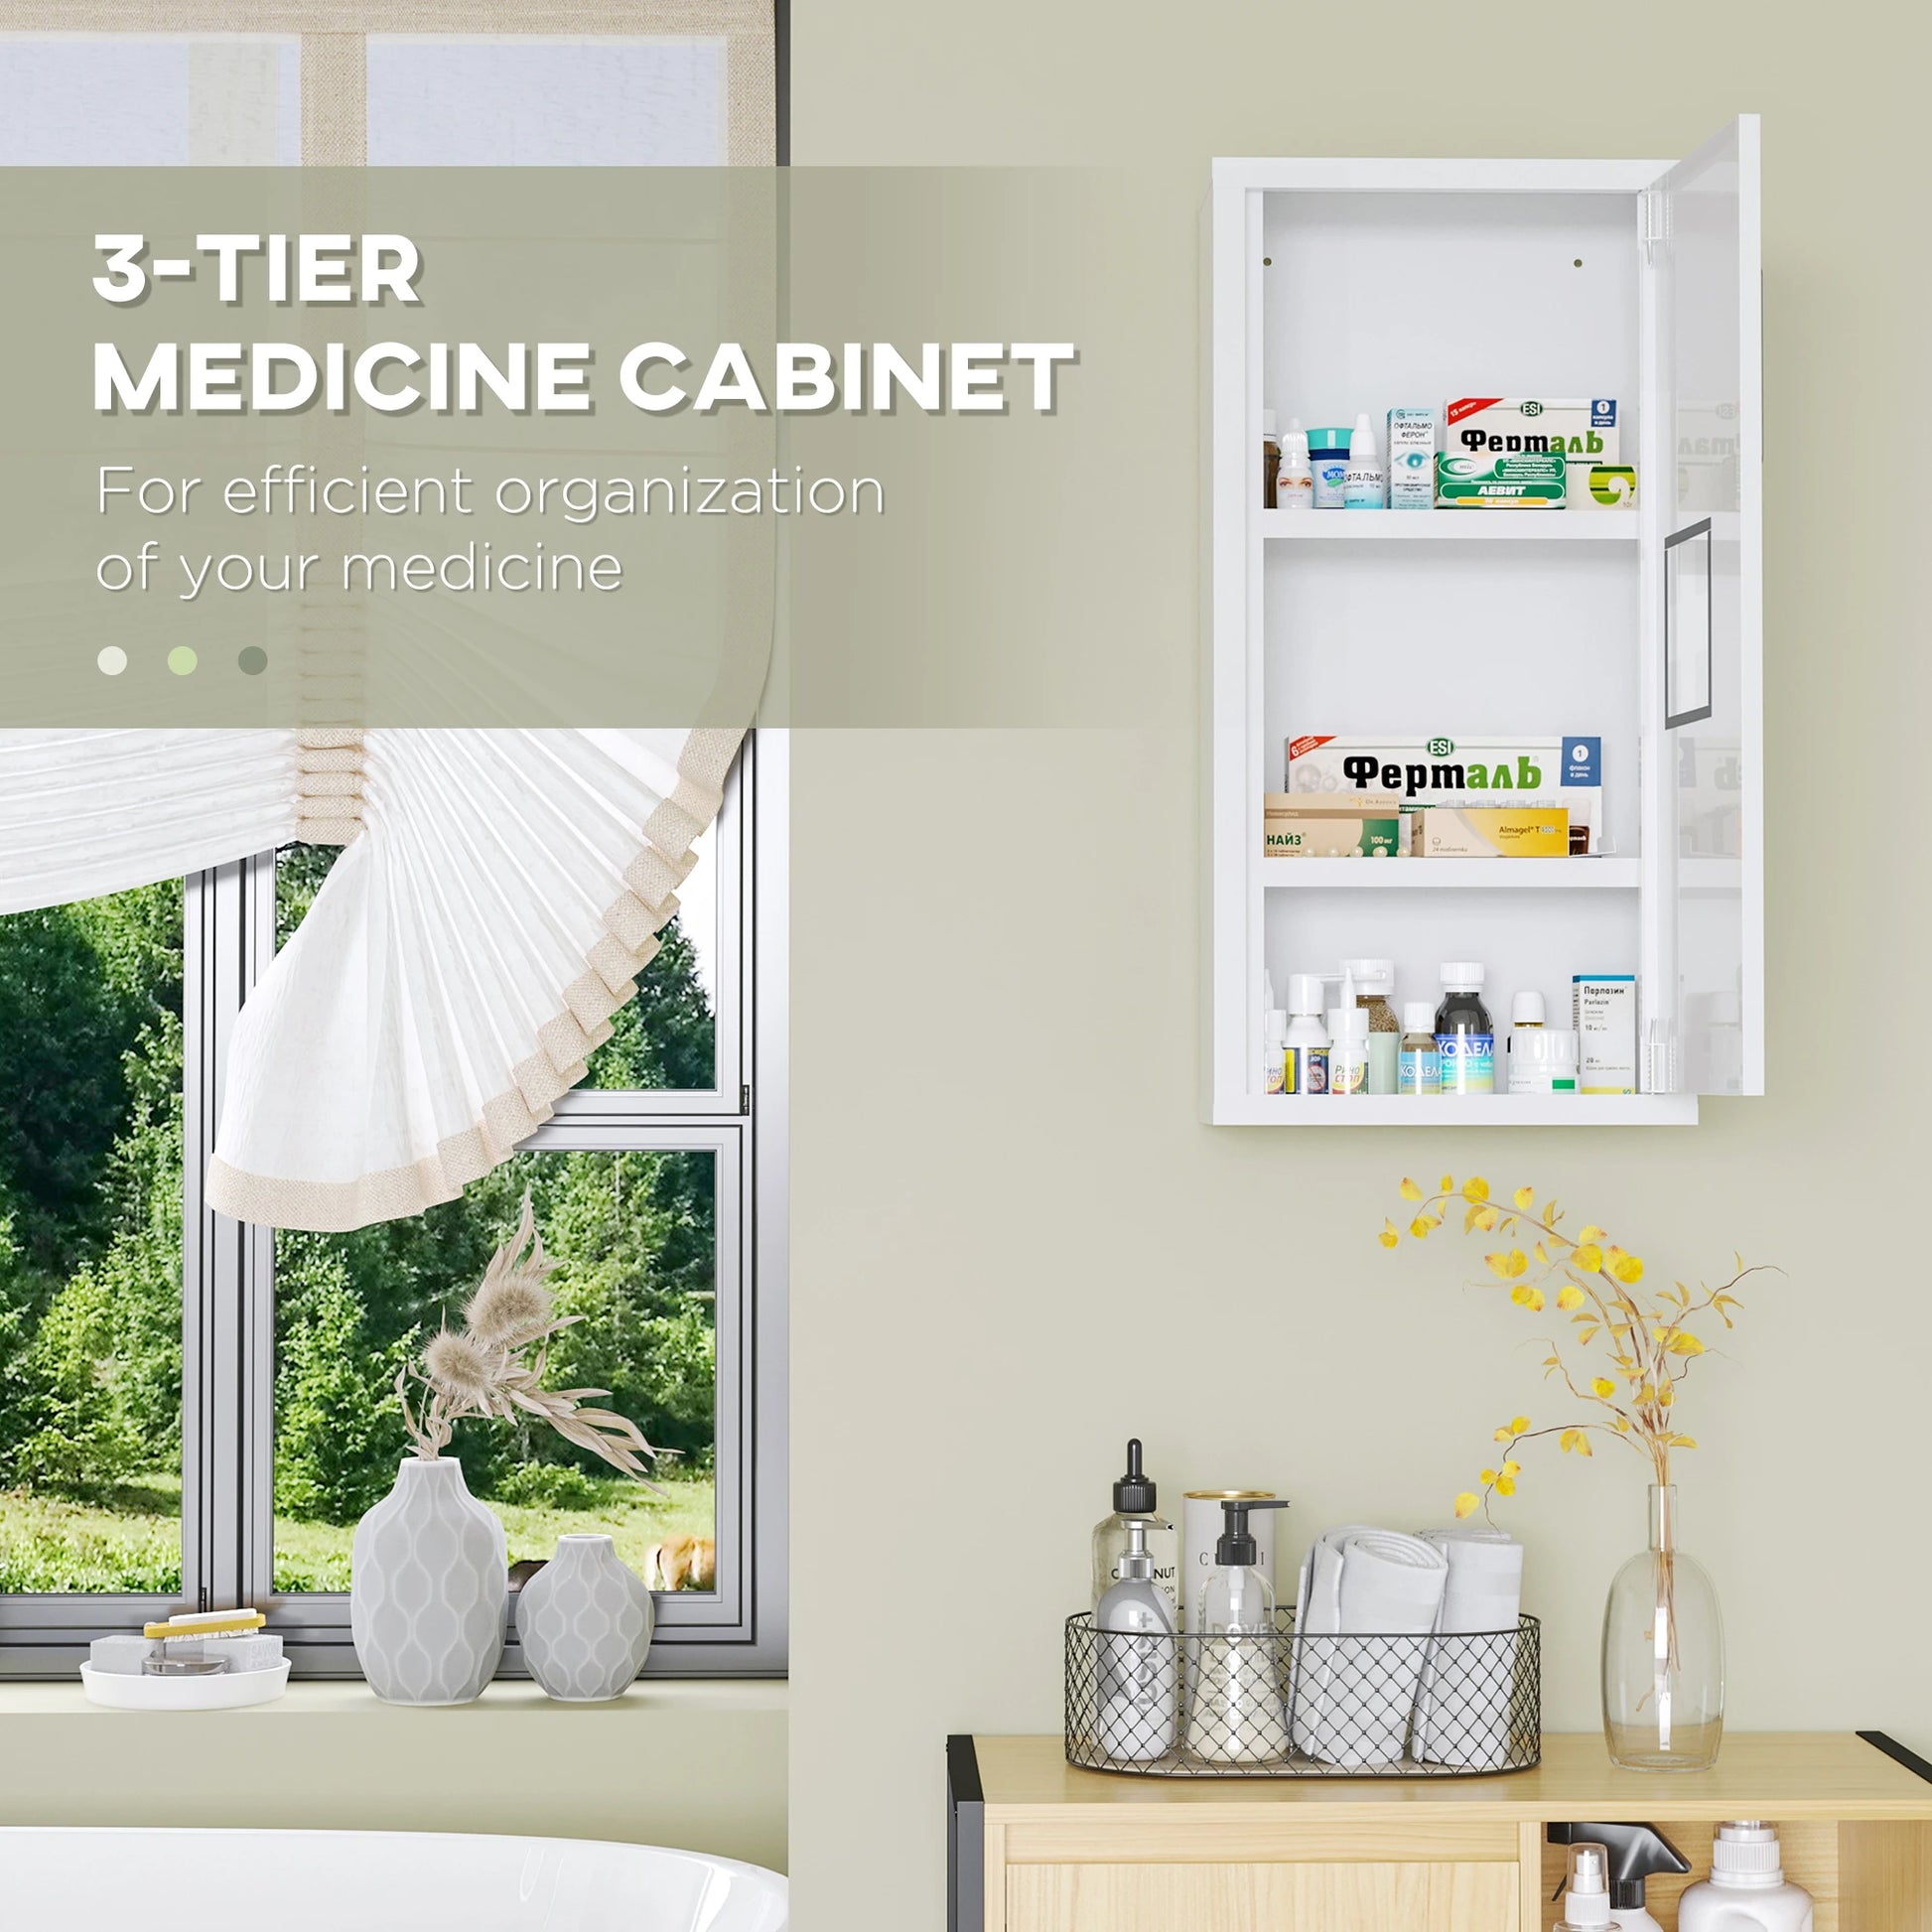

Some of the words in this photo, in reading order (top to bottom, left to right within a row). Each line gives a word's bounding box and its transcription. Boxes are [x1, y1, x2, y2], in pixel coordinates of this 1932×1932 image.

[1523, 403, 1541, 415] ESI
[1477, 485, 1526, 495] АЕВИТ
[1291, 746, 1300, 757] 6
[1430, 741, 1451, 755] ESI
[1343, 756, 1542, 797] Ферталь
[1266, 832, 1302, 845] НАЙЗ
